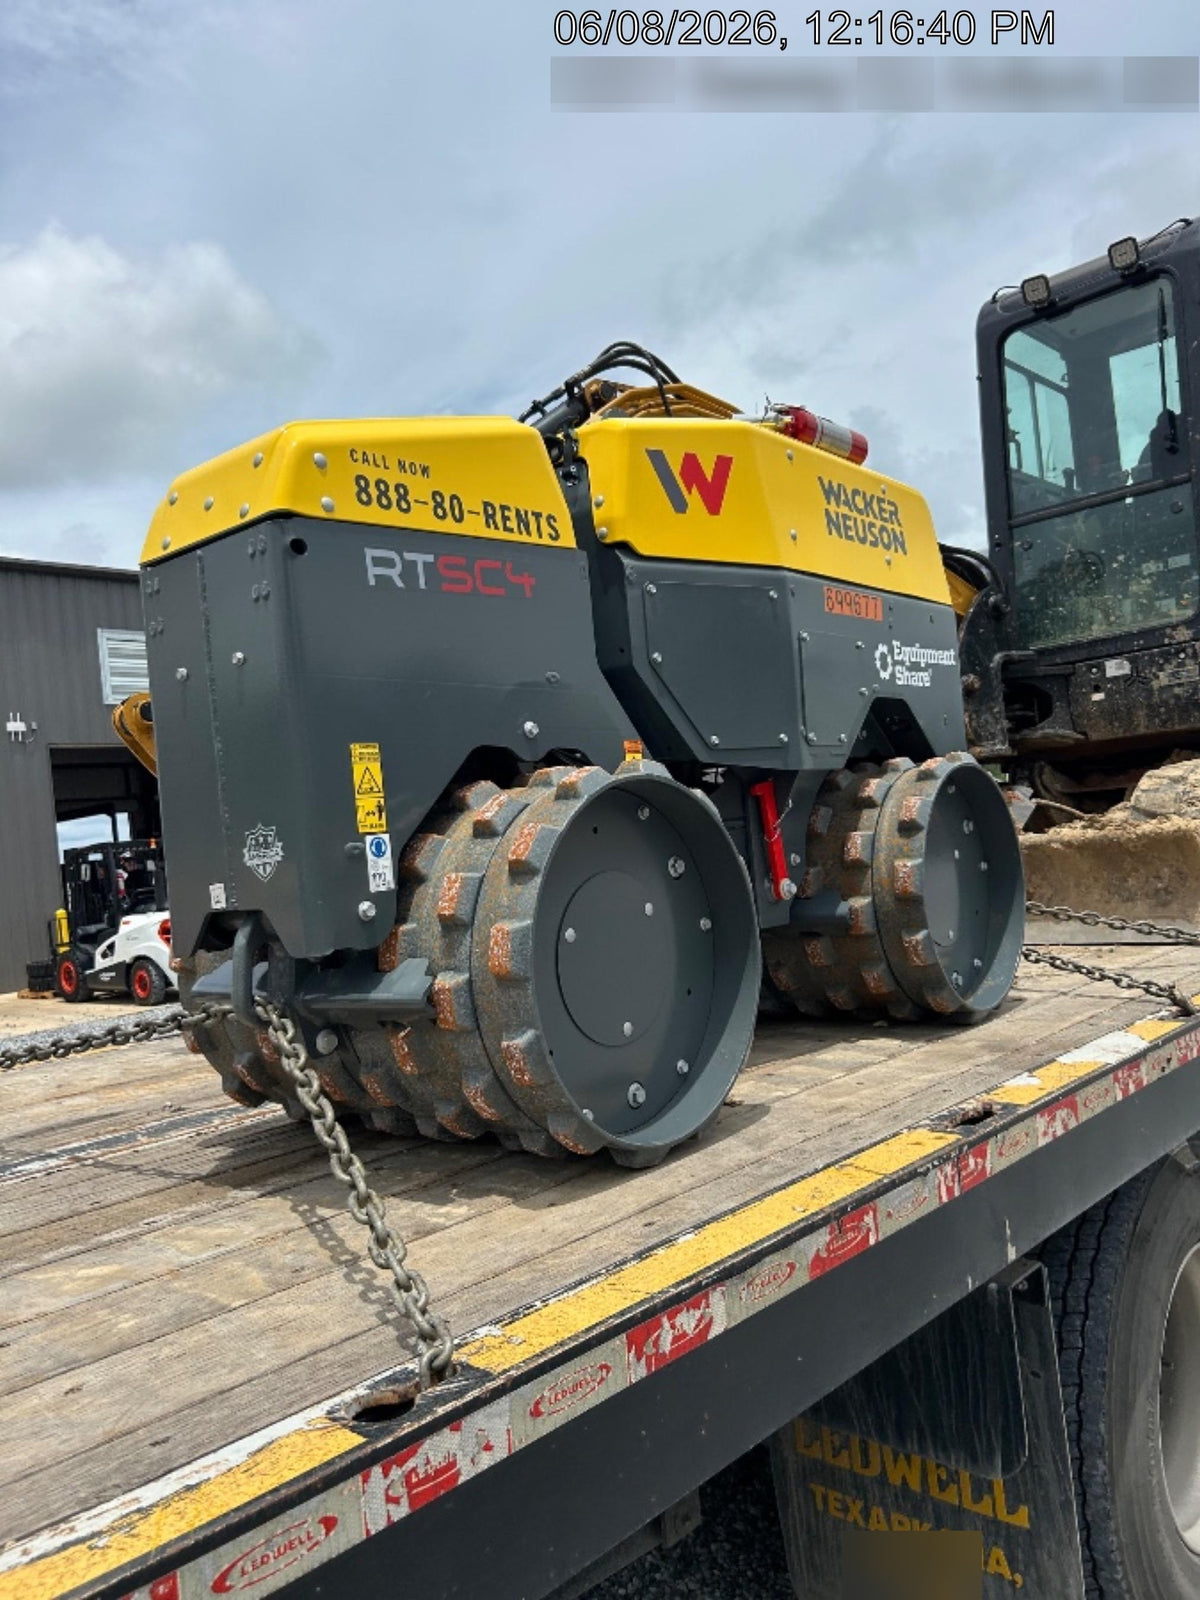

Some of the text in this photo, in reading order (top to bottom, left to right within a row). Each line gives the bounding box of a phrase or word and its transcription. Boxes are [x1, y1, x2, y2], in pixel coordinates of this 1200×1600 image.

[350, 448, 430, 479] CALL NOW
[355, 474, 560, 542] 888-80-RENTS
[818, 475, 902, 527] WACKER
[825, 508, 907, 556] NEUSON
[892, 640, 956, 667] Equipment
[239, 1529, 315, 1578] LEDWELL
